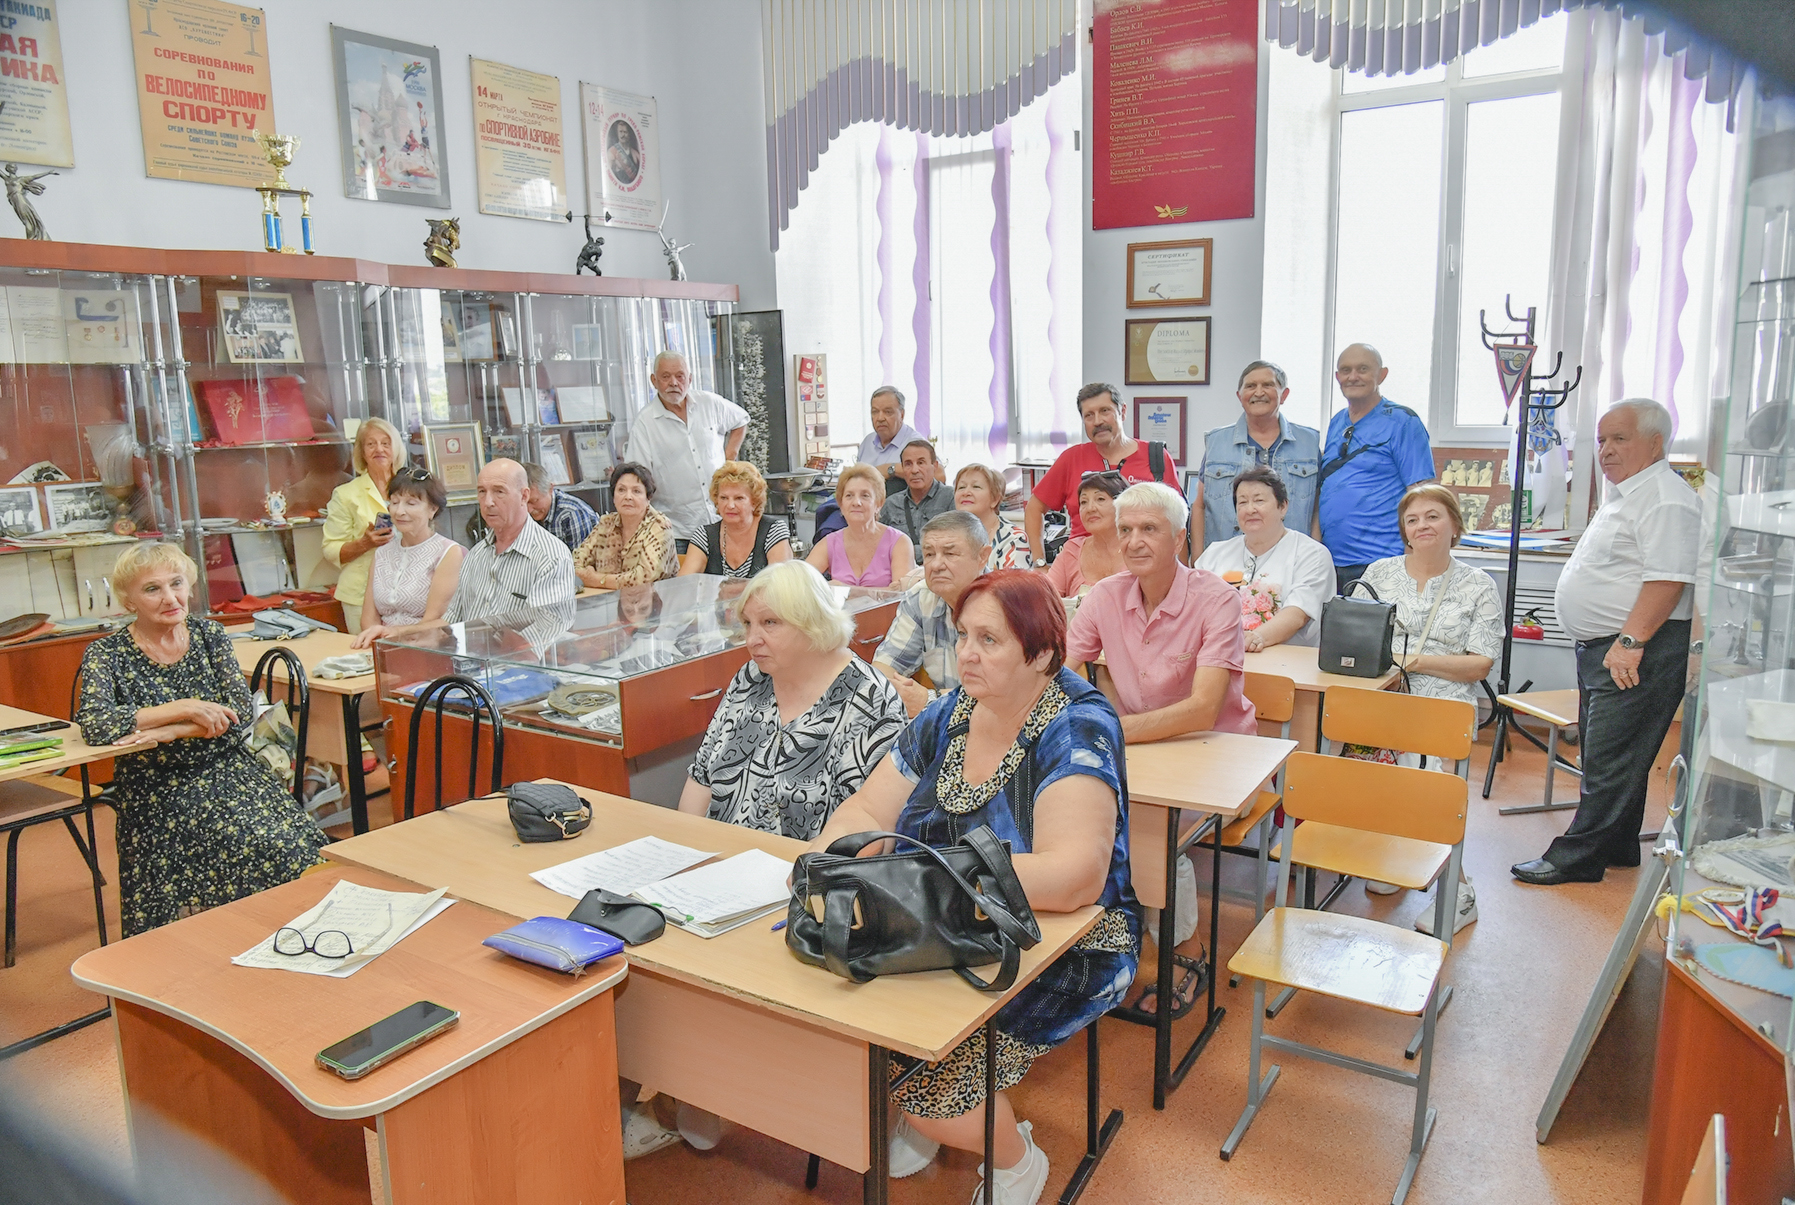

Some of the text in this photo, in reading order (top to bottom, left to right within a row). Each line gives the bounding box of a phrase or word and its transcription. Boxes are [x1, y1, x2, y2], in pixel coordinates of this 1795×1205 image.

[240, 13, 260, 25] 16-20
[0, 33, 39, 58] АЯ
[184, 34, 221, 46] ПРОВОДИТ
[0, 56, 59, 85] ИКА
[153, 47, 254, 75] СОРЕВНОВАНИЯ
[197, 69, 215, 81] ПО
[145, 73, 267, 111] ВЕЛОСИПЕДНОМУ
[477, 85, 487, 98] 14
[162, 100, 256, 130] СПОРТУ
[478, 101, 517, 115] ОТКРЫТЫЙ
[520, 110, 558, 123] ЧЕМПИОНАТ
[503, 114, 542, 126] КРАСНОДАРА
[486, 119, 528, 141] СПОРТИВНОЙ
[529, 128, 561, 148] АЭРОБИКЕ
[1147, 252, 1189, 260] СЕРТИФИКАТ
